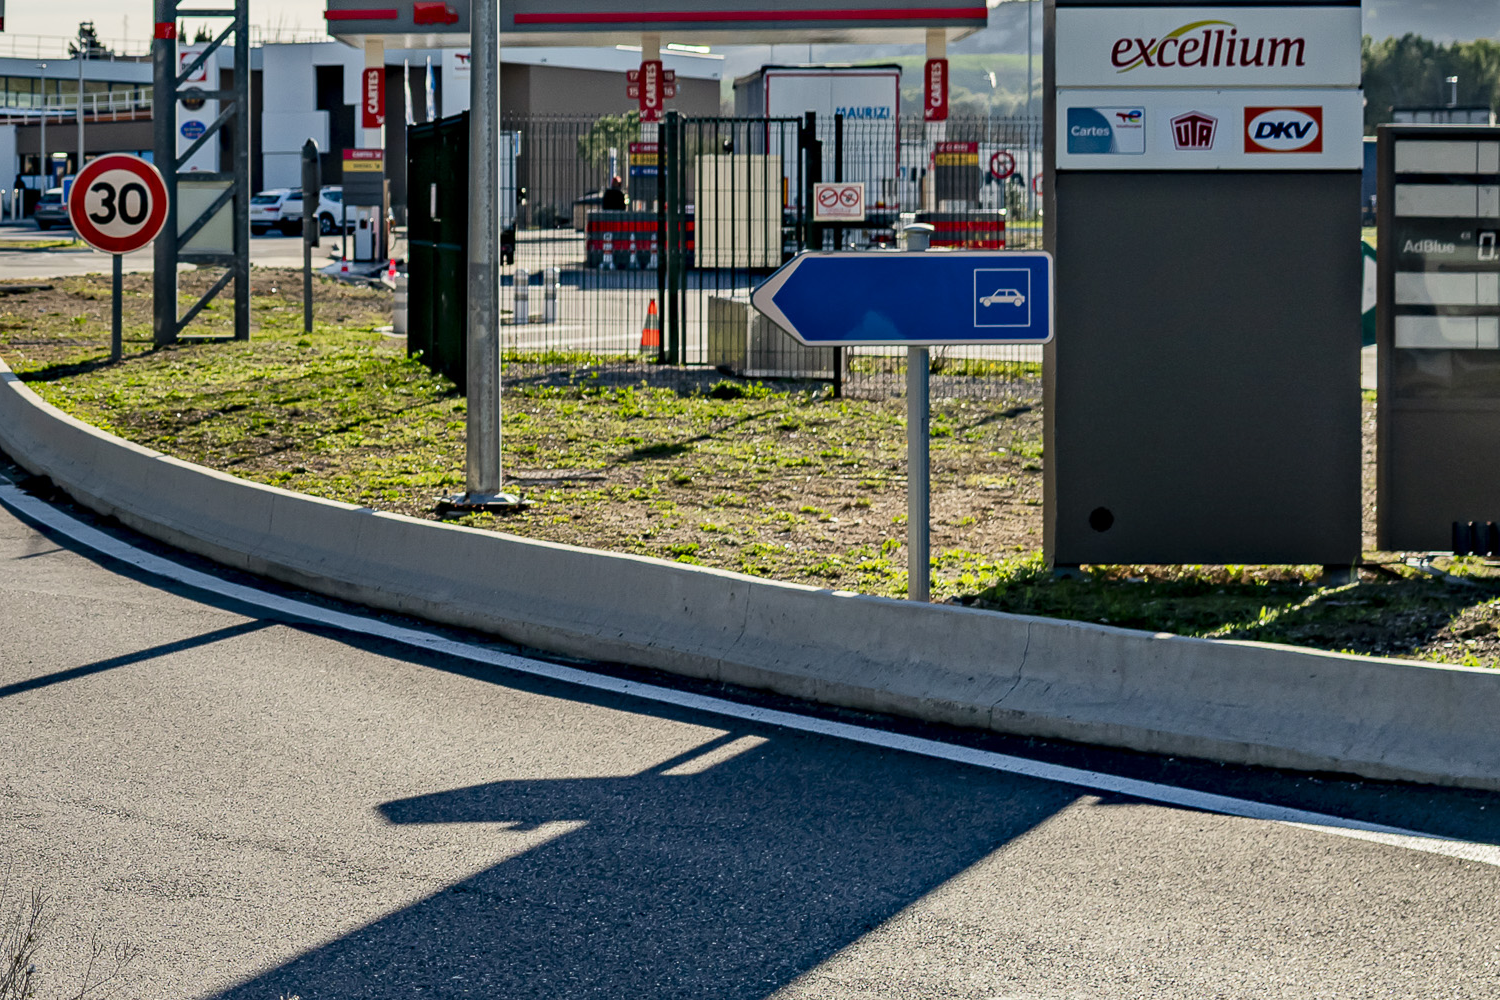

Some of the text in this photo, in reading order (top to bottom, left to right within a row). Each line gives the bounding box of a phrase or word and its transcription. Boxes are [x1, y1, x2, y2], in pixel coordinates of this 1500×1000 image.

[1111, 28, 1306, 68] excellium
[367, 70, 379, 114] CARTES
[645, 62, 657, 108] CARTES
[930, 62, 942, 107] CARTES
[836, 106, 891, 119] MAURIZI
[1171, 114, 1218, 147] UTA
[1254, 121, 1314, 139] DKV
[1070, 125, 1110, 137] Cartes
[88, 181, 149, 226] 30
[1403, 239, 1456, 254] AdBlue
